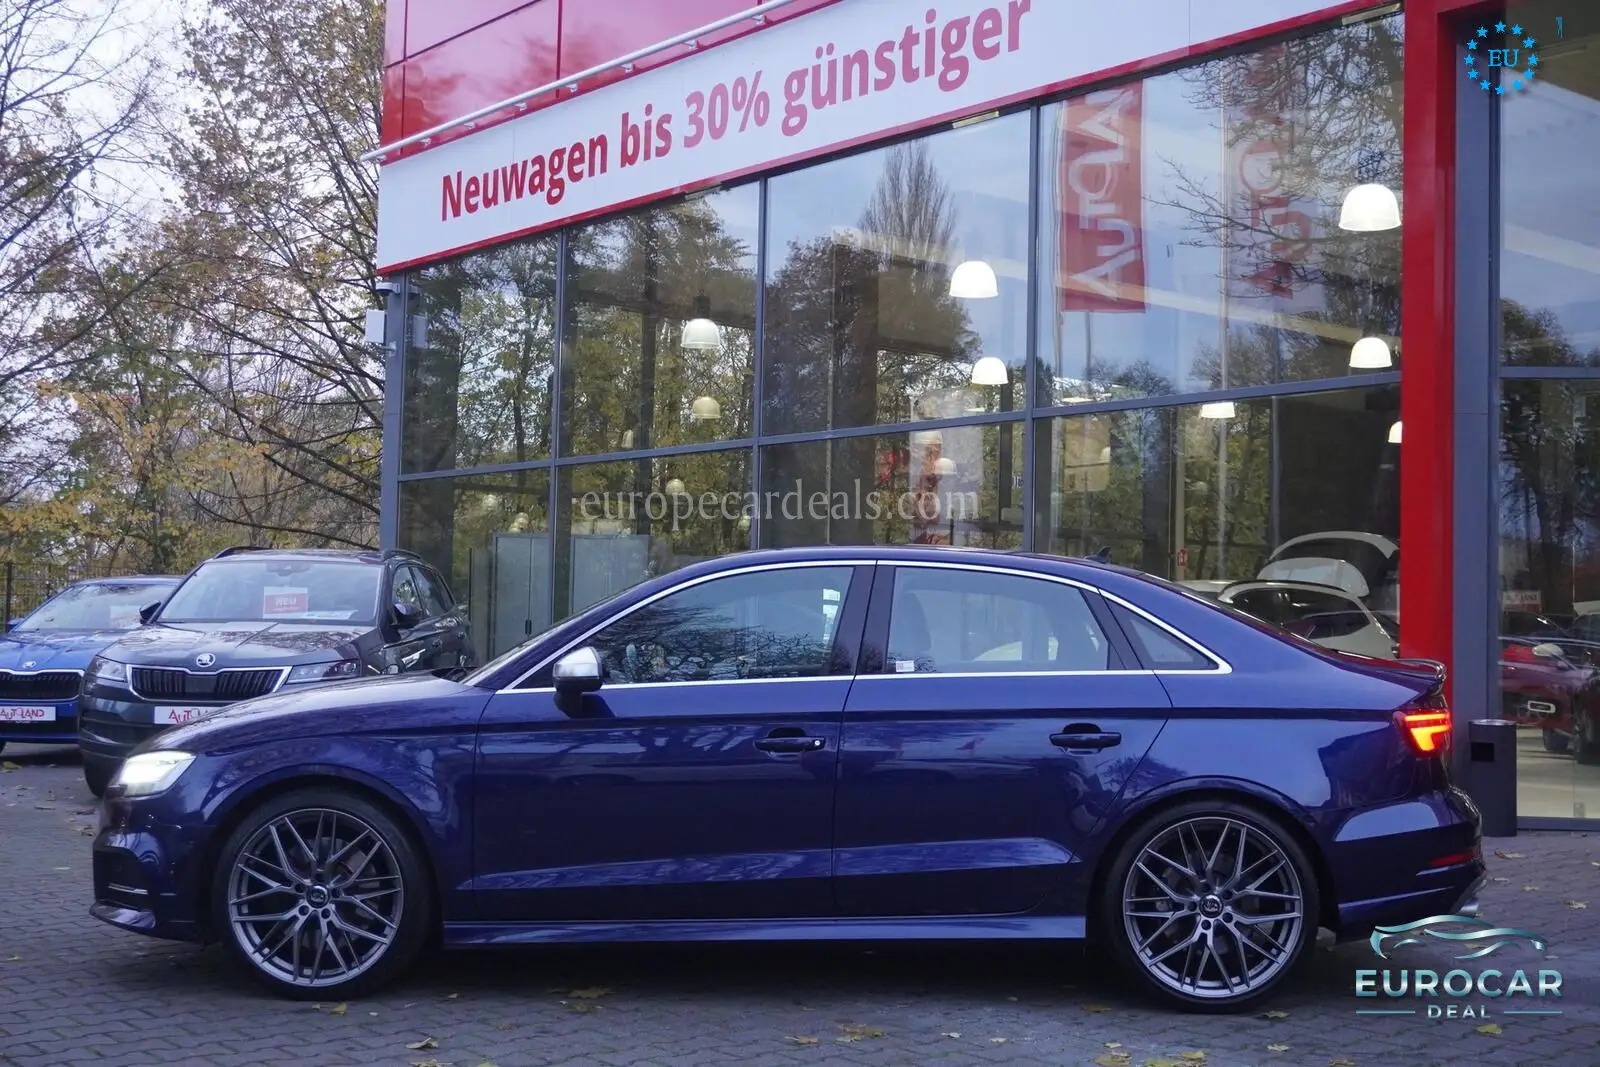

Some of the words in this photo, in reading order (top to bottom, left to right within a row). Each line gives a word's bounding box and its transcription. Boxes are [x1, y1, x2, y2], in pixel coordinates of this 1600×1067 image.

[441, 133, 608, 222] Neuwagen
[620, 104, 672, 168] bis
[683, 70, 770, 148] 30%
[781, 0, 1031, 137] günstiger
